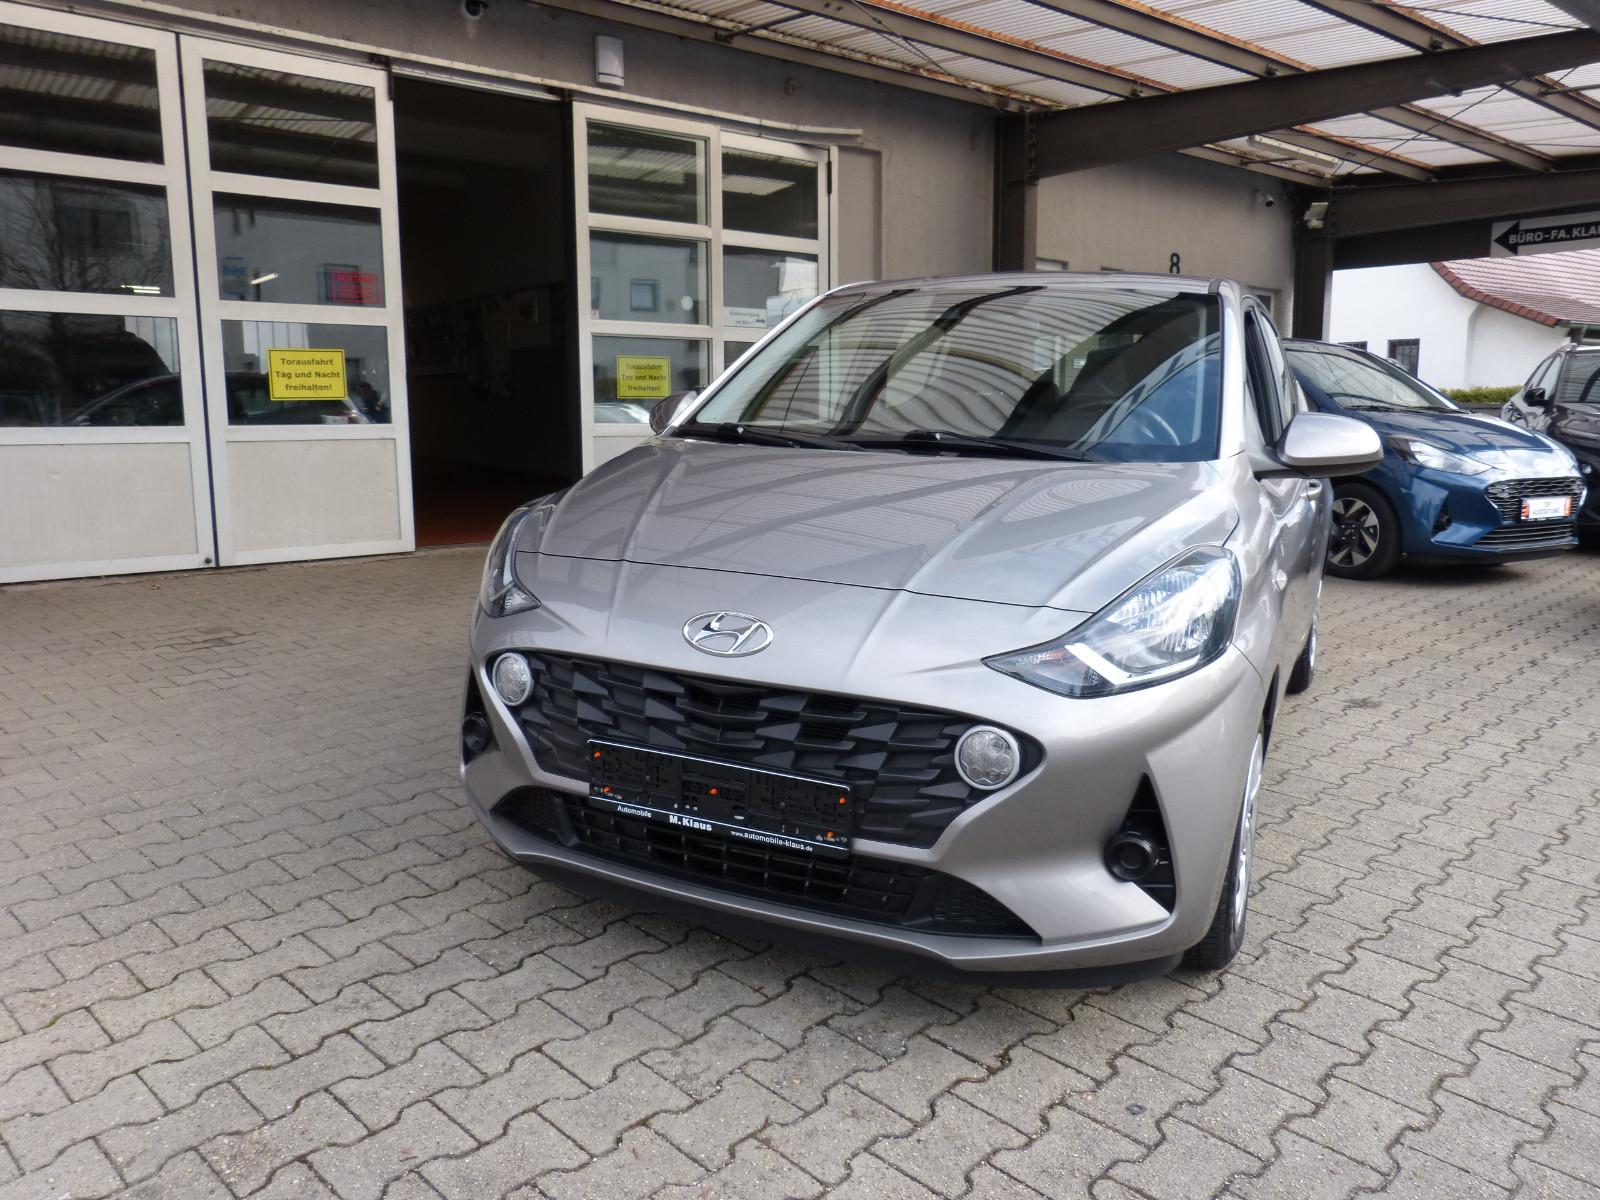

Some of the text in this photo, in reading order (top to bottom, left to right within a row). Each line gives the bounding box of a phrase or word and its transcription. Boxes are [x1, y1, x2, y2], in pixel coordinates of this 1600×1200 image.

[1170, 252, 1180, 274] 8
[280, 358, 334, 366] Torausfahrt
[275, 371, 292, 379] Tag
[617, 805, 652, 818] Automobile
[730, 830, 813, 852] www.automobile-klaus.de
